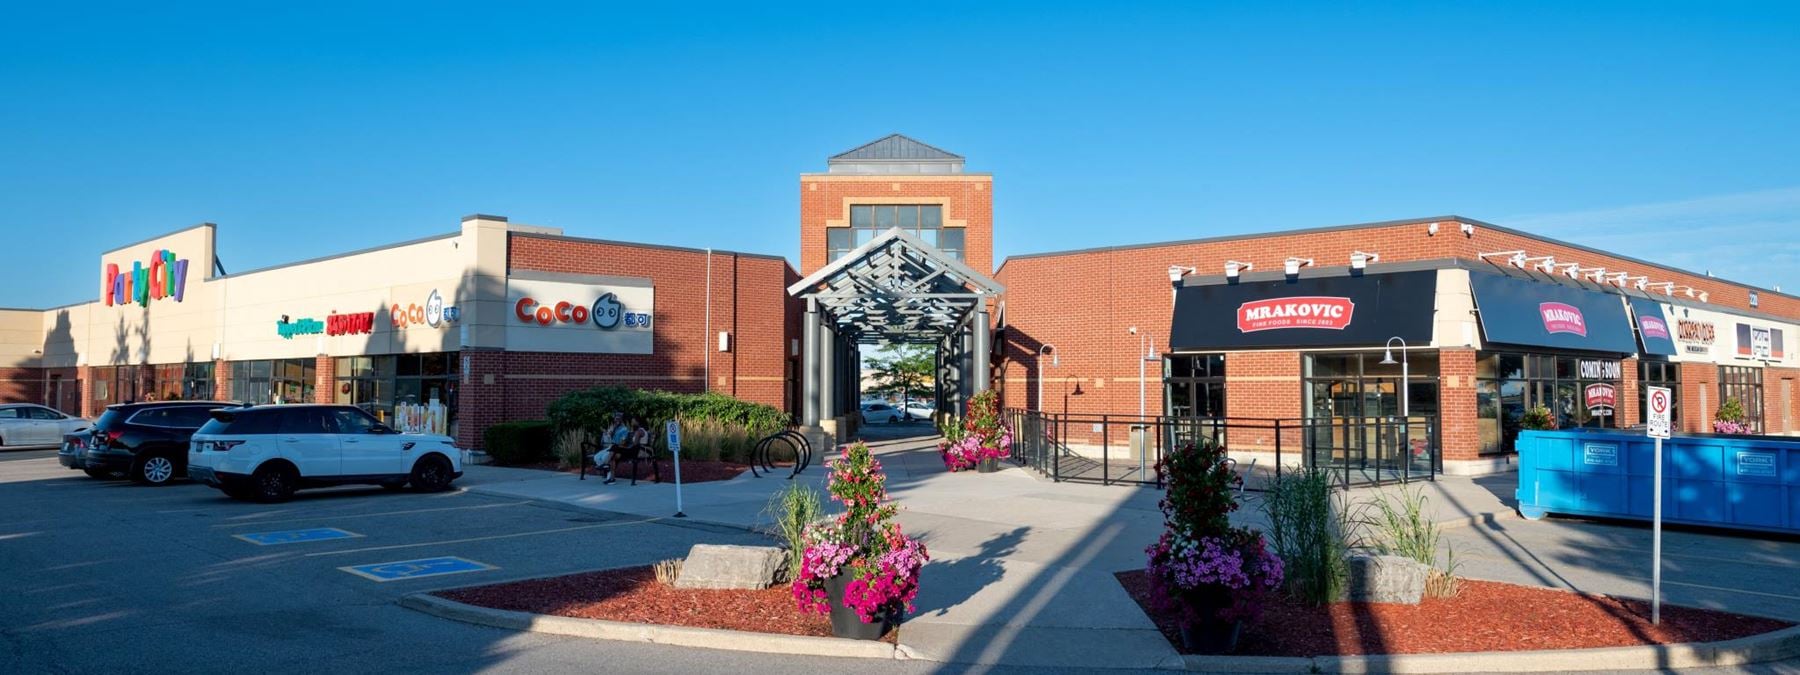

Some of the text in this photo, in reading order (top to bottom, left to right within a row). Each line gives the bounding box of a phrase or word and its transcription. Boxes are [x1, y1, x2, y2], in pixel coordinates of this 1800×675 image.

[105, 249, 189, 307] Party City
[1245, 303, 1344, 321] MRAKOVIC
[1543, 309, 1582, 326] MRAKOVIC
[1650, 419, 1668, 428] ROUTE
